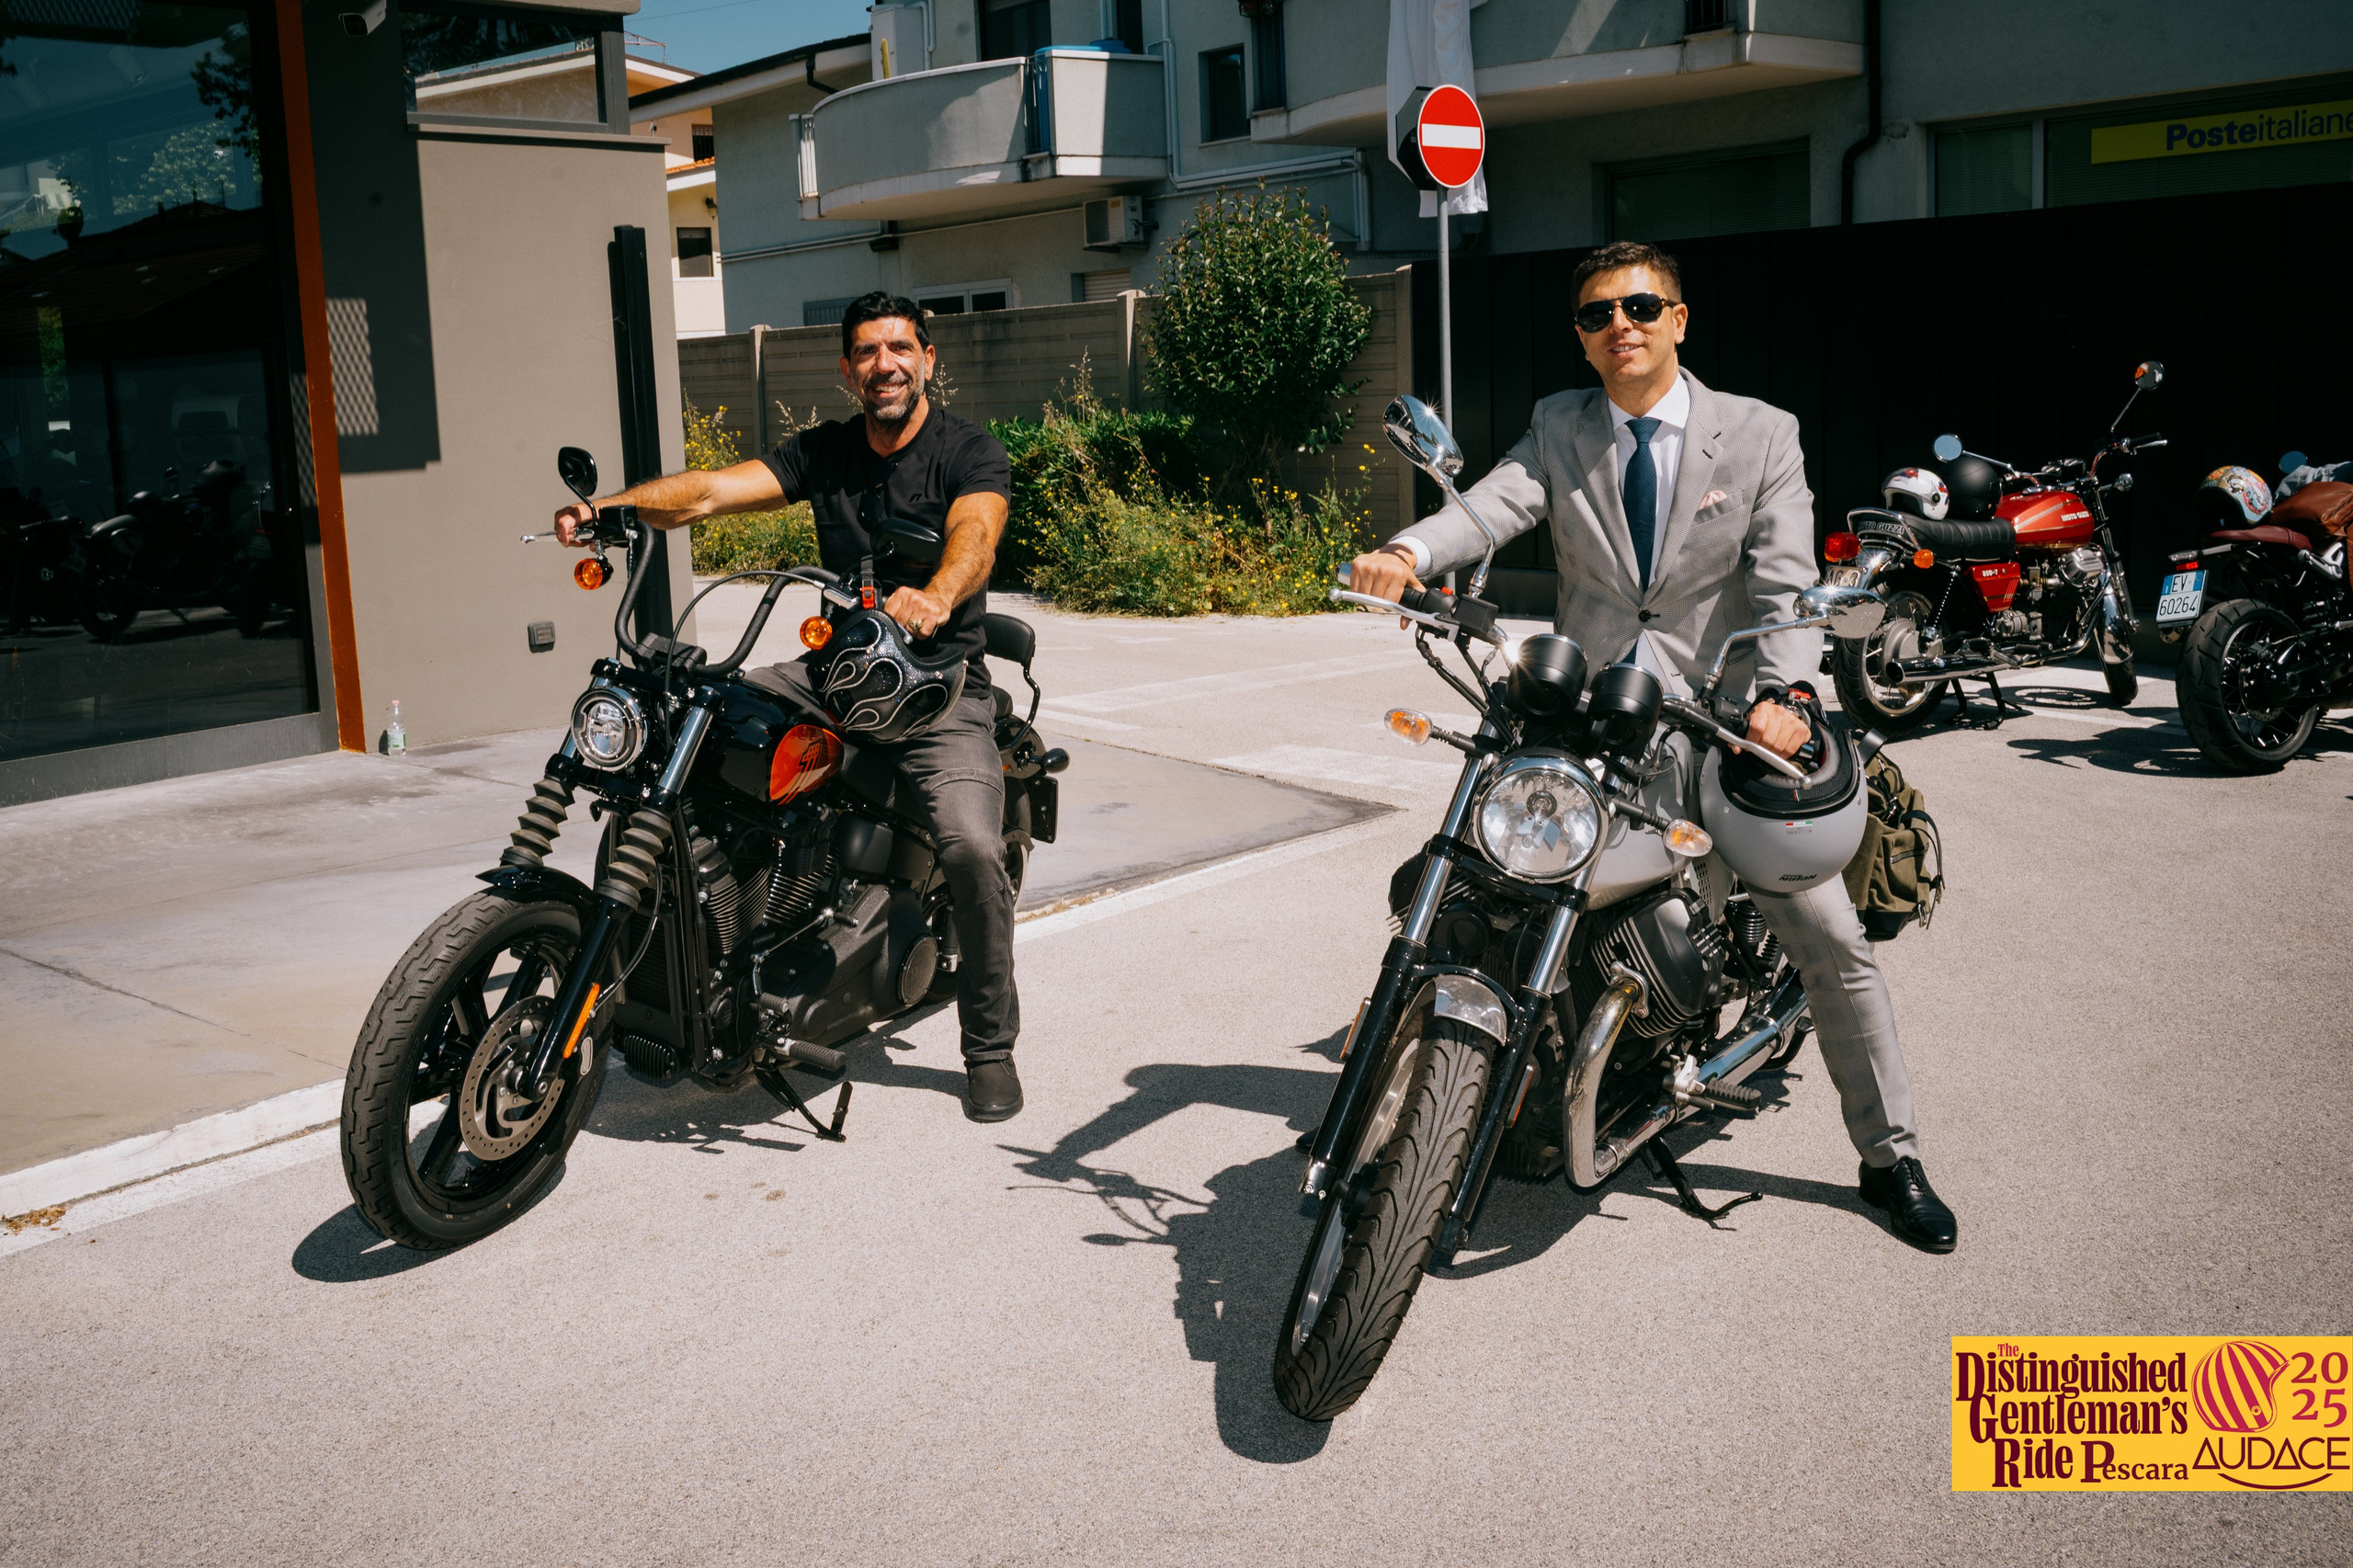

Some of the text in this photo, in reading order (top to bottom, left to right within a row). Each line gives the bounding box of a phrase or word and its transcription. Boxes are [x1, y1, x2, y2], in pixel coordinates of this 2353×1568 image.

[1876, 522, 1904, 535] GUZZI
[2172, 574, 2188, 592] EV
[2159, 596, 2198, 616] 60264
